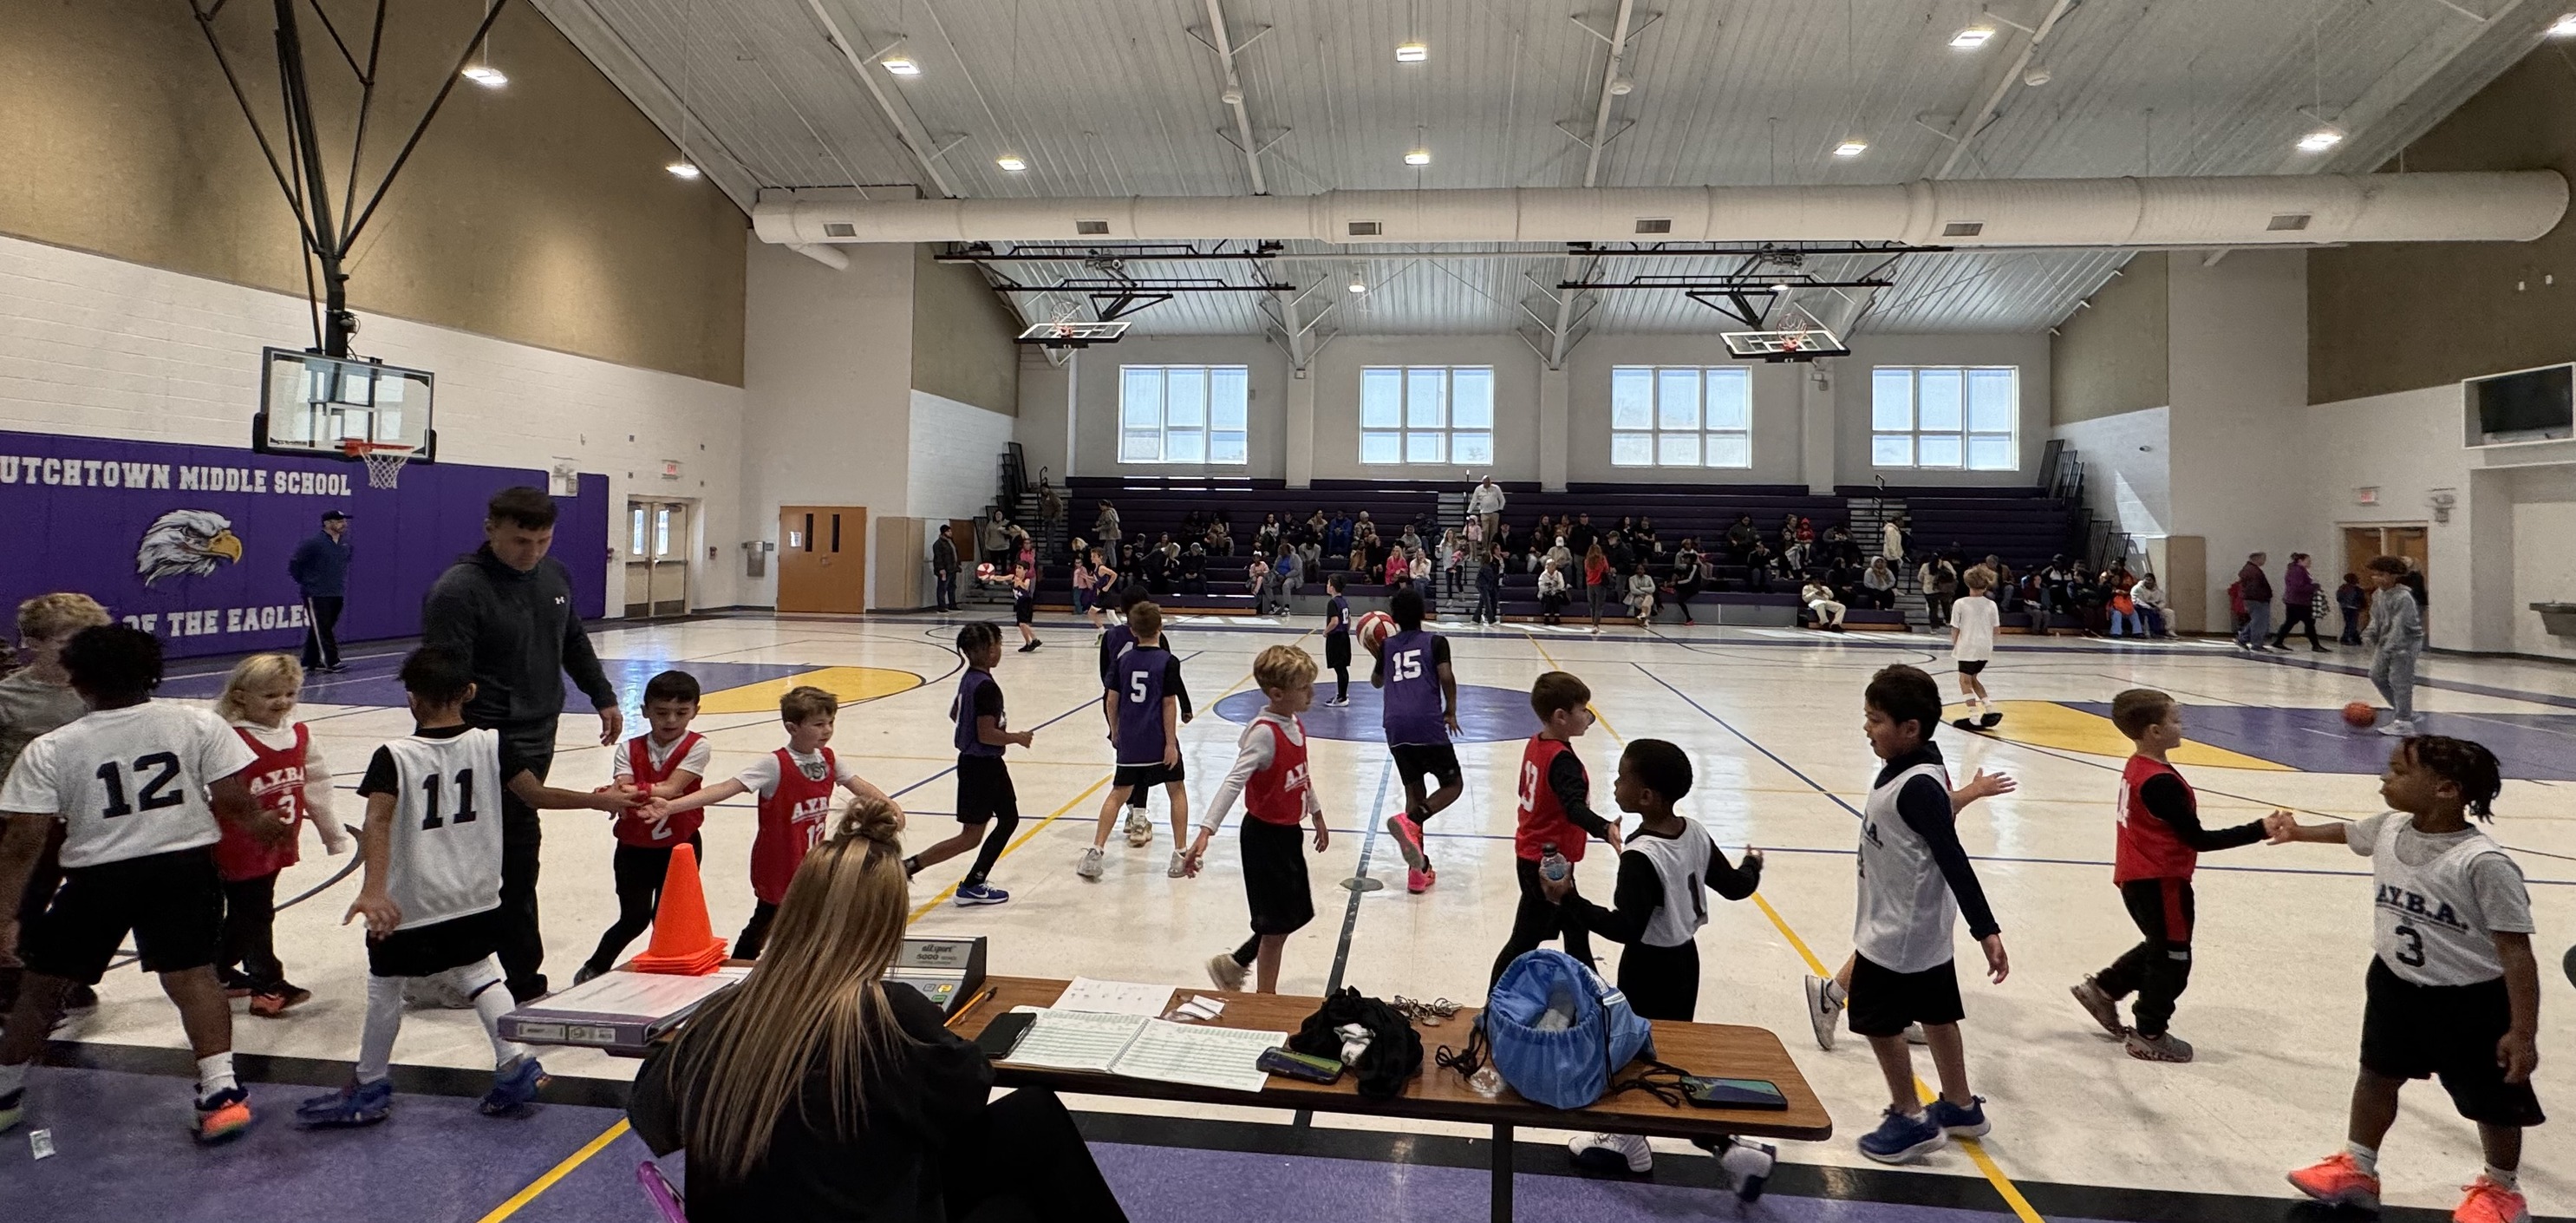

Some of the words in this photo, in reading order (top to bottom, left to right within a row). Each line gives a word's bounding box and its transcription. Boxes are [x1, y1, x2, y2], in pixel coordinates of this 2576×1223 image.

[179, 465, 267, 493] MIDDLE
[274, 471, 351, 496] SCHOOL
[167, 609, 219, 637] THE
[1392, 649, 1422, 682] 15
[1130, 670, 1149, 703] 5
[96, 751, 184, 819] 12
[422, 768, 476, 830] 11
[277, 794, 296, 825] 3
[2395, 925, 2425, 967] 3
